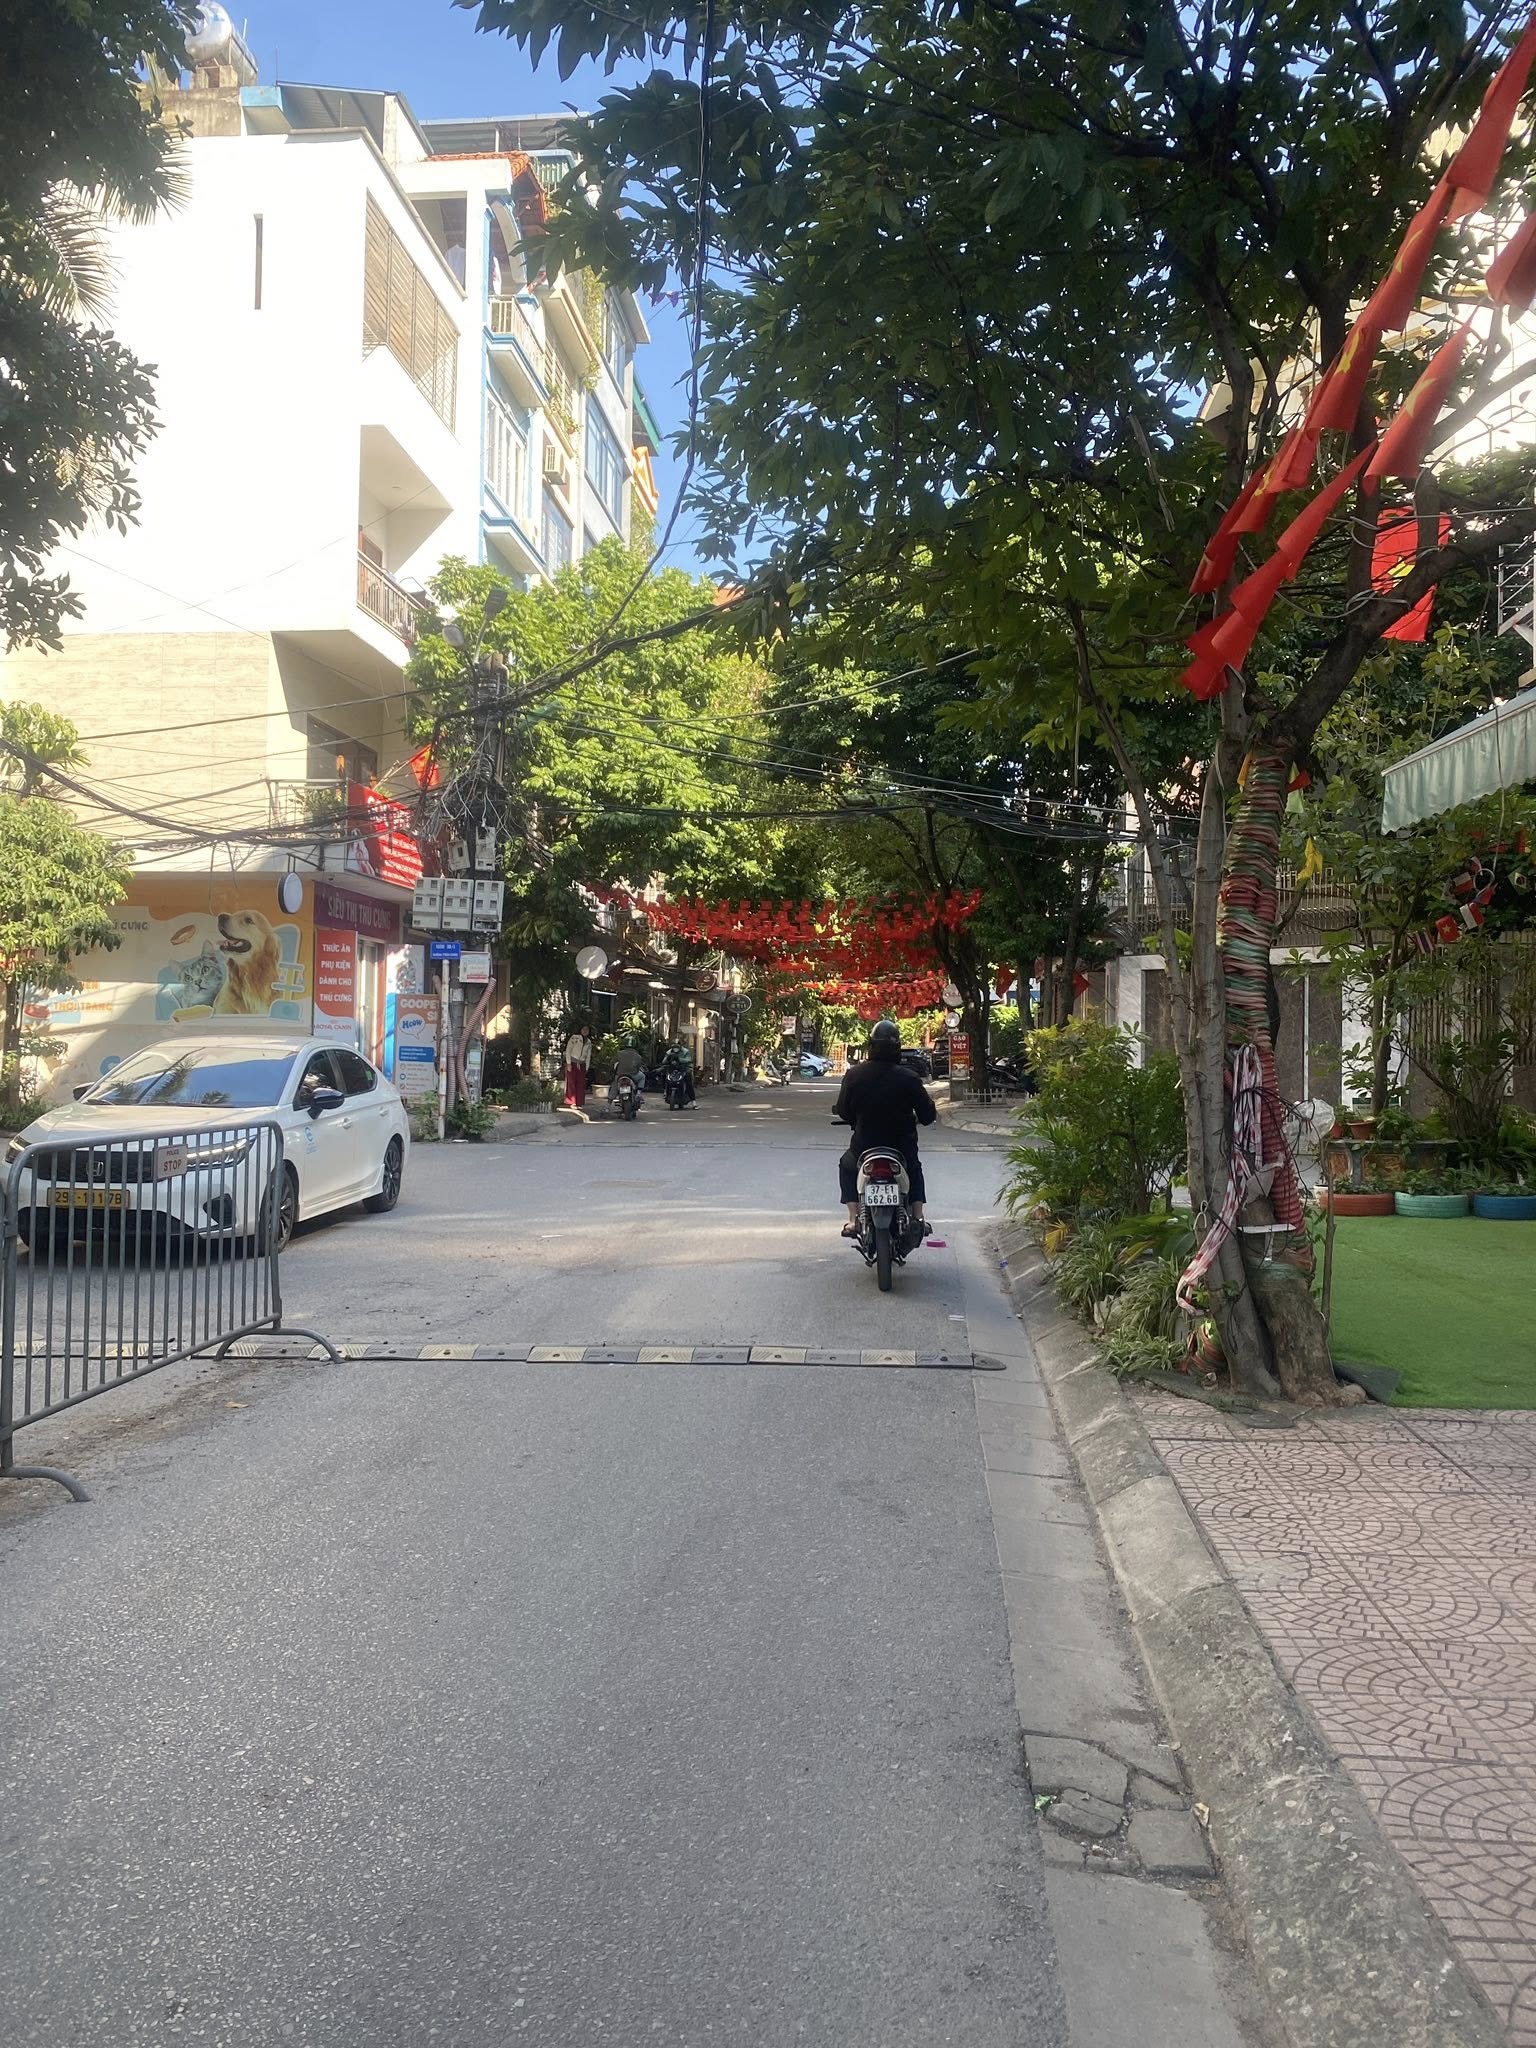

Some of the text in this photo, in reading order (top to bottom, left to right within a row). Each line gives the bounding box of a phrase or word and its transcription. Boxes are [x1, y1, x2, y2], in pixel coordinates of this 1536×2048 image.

[338, 978, 352, 986] CHO
[164, 1159, 181, 1171] STOP
[870, 1185, 894, 1194] 37-E1
